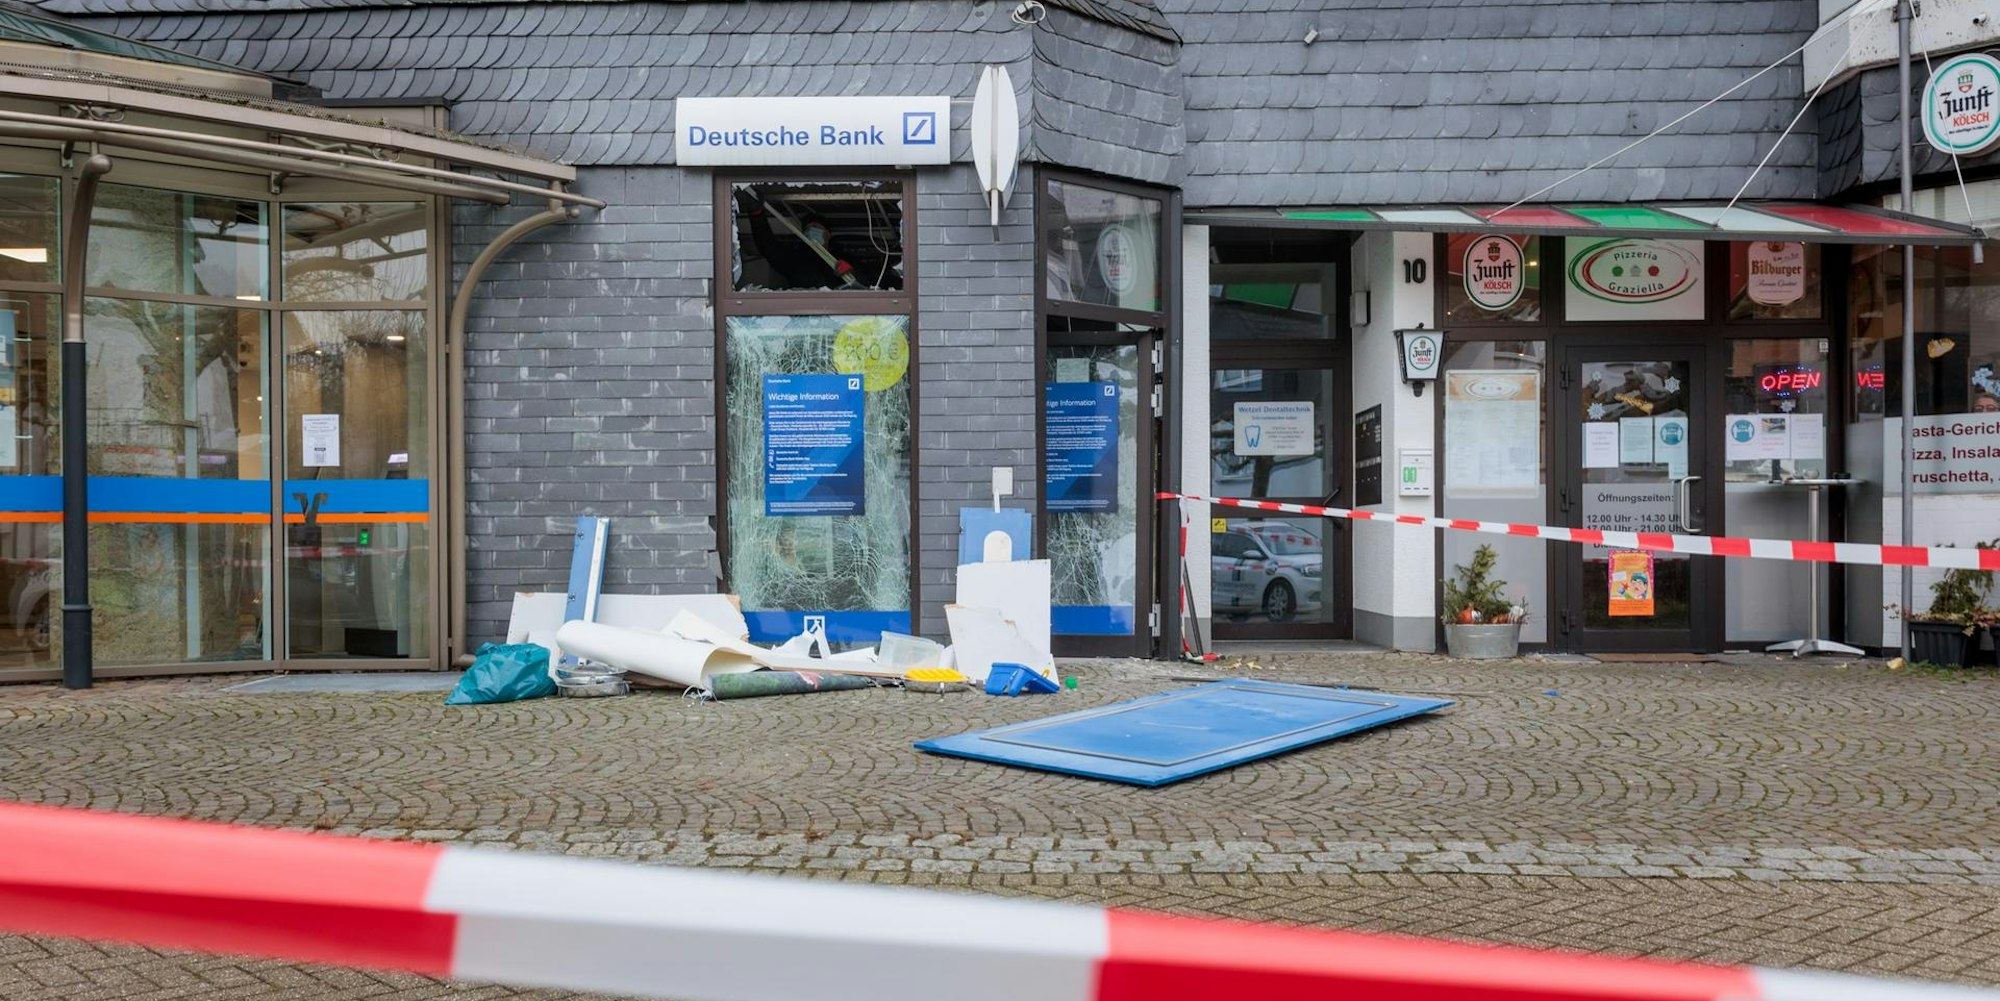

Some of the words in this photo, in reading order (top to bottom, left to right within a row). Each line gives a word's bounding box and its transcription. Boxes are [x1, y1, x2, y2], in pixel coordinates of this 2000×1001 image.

[1939, 86, 1994, 120] Zunft
[1953, 112, 1990, 127] KÖLSCH
[689, 125, 809, 146] Deutsche
[820, 125, 885, 146] Bank
[1614, 250, 1658, 261] Pizzeria
[1403, 258, 1426, 284] 10
[1473, 259, 1516, 282] Zunft
[1484, 280, 1512, 290] KÖLSCH
[1608, 281, 1664, 294] Graziella
[1761, 371, 1821, 390] OPEN
[768, 392, 798, 402] Wichtige
[800, 392, 840, 401] Information
[1046, 400, 1059, 409] tige
[1060, 399, 1097, 407] Information
[1911, 421, 2000, 438] asta-Gerich
[1911, 448, 1946, 462] izza,
[1911, 470, 1994, 484] ruschetta,
[1597, 493, 1675, 504] Öffnungszeiten:
[1587, 514, 1612, 523] 12.00
[1614, 514, 1632, 523] Uhr
[1641, 514, 1666, 523] 14.30
[1668, 514, 1681, 522] Uh
[1640, 525, 1666, 533] 21.00
[1668, 525, 1682, 533] Uh
